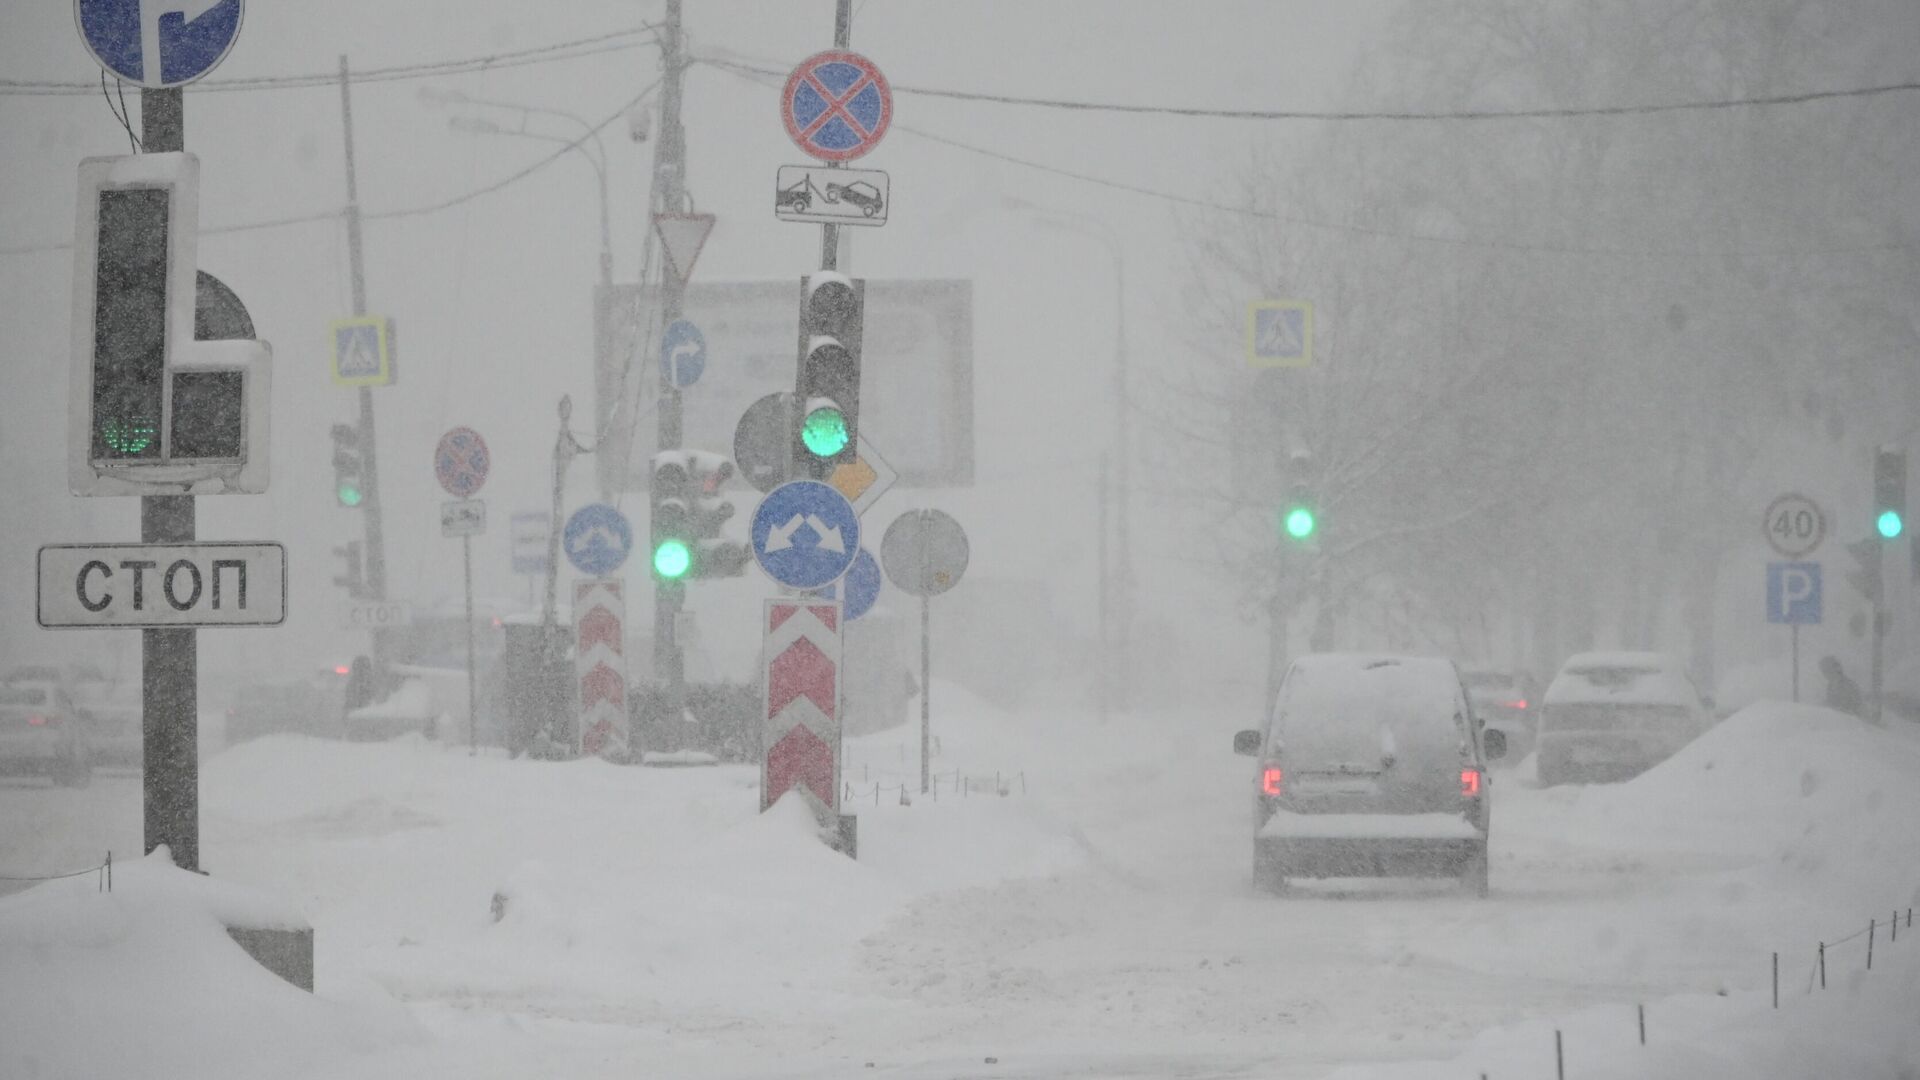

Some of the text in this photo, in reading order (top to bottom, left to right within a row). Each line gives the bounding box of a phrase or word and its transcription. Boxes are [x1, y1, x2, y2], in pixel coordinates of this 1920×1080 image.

[1774, 510, 1813, 538] 40
[76, 559, 247, 612] СТОП
[1781, 569, 1811, 617] P
[350, 606, 402, 623] СТОП
